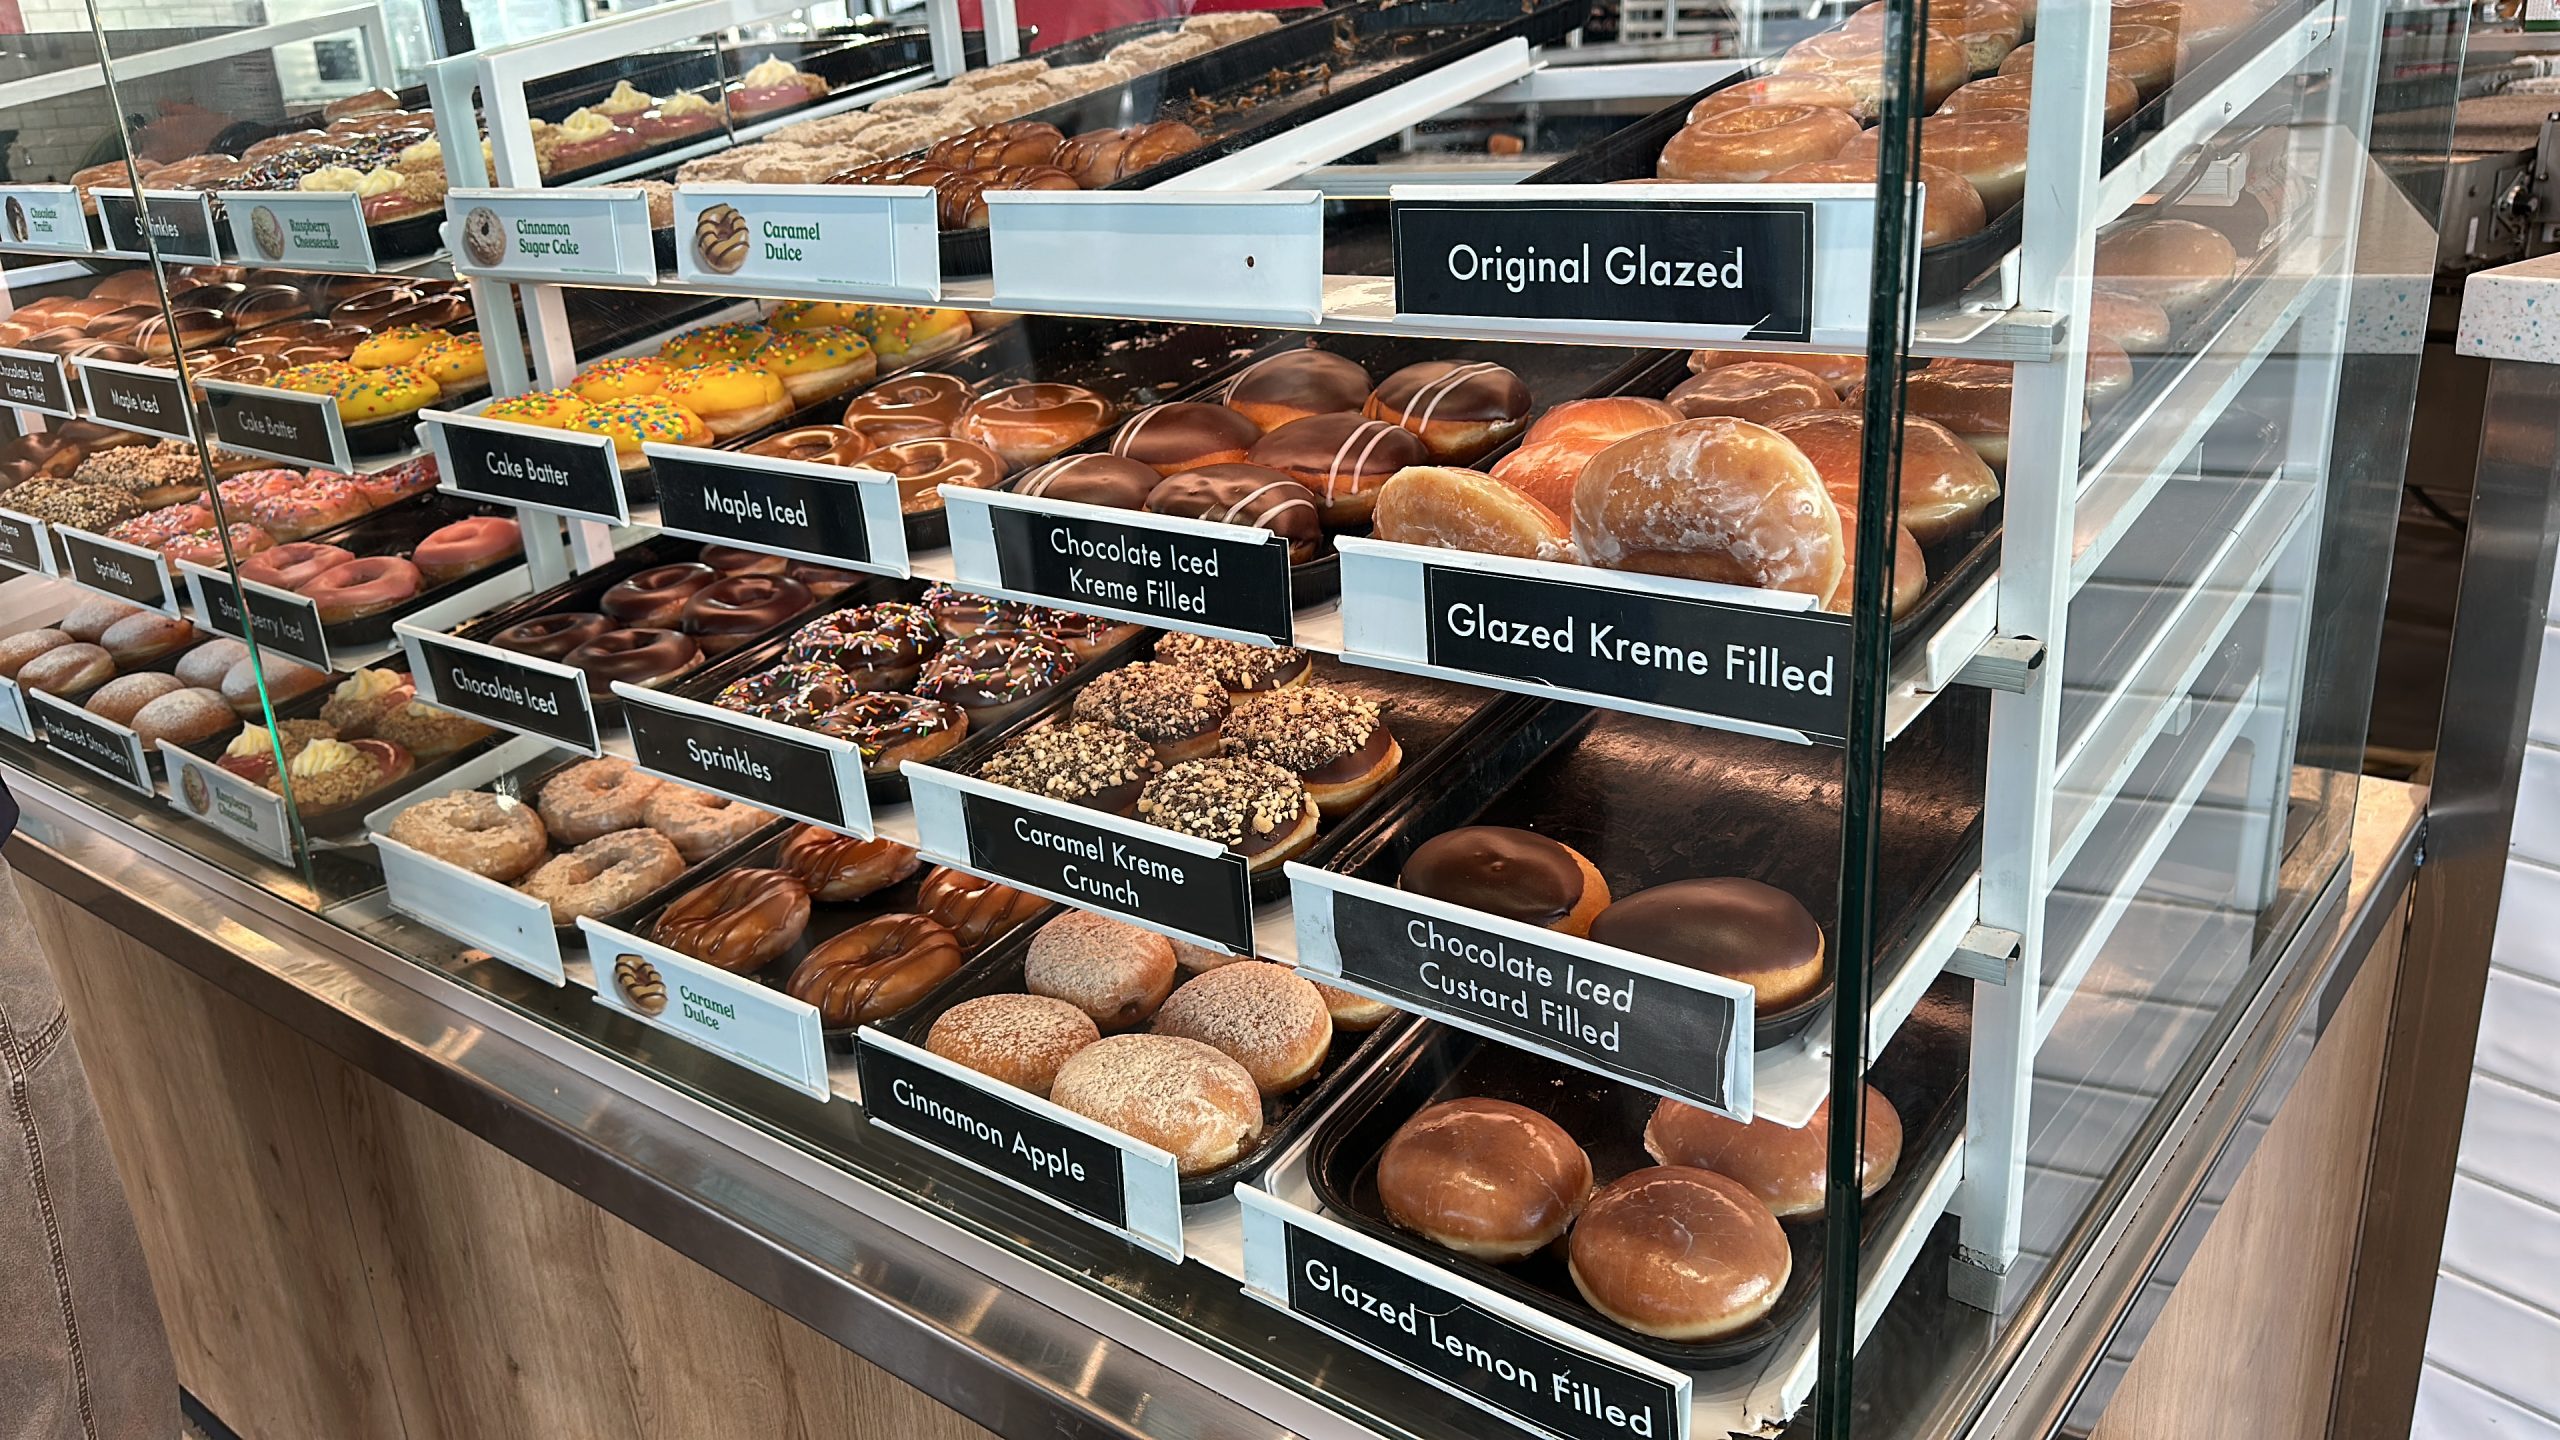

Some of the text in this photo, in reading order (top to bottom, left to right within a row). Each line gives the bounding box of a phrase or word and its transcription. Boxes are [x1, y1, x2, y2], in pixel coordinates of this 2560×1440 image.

[288, 218, 331, 239] Raspberry
[293, 235, 340, 249] Cheesecake
[516, 219, 570, 235] Cinnamon
[763, 221, 821, 241] Caramel
[519, 238, 579, 258] Sugar Cake
[765, 243, 802, 261] Dulce
[1448, 243, 1743, 293] Original Glazed
[28, 366, 45, 382] Iced
[6, 381, 46, 403] Kreme Filled
[110, 388, 160, 414] Maple Iced
[238, 410, 298, 440] Cake Batter
[486, 451, 569, 487] Cake Batter
[704, 486, 808, 527] Maple Iced
[1050, 528, 1219, 578] Chocolate Iced
[93, 557, 133, 585] Sprinkles
[1069, 567, 1206, 615] Kreme Filled
[279, 616, 305, 642] Iced
[1447, 603, 1834, 697] Glazed Kreme Filled
[452, 667, 559, 716] Chocolate Iced
[42, 715, 86, 747] Powdered
[687, 738, 772, 782] Sprinkles
[1014, 817, 1185, 885] Caramel Kreme
[1063, 865, 1140, 908] Crunch
[1407, 919, 1634, 1013] Chocolate Iced
[680, 985, 736, 1020] Caramel
[683, 1003, 720, 1030] Dulce
[1419, 961, 1620, 1053] Custard Filled
[892, 1079, 1086, 1182] Cinnamon Apple
[1305, 1259, 1653, 1439] Glazed Lemon Filled
